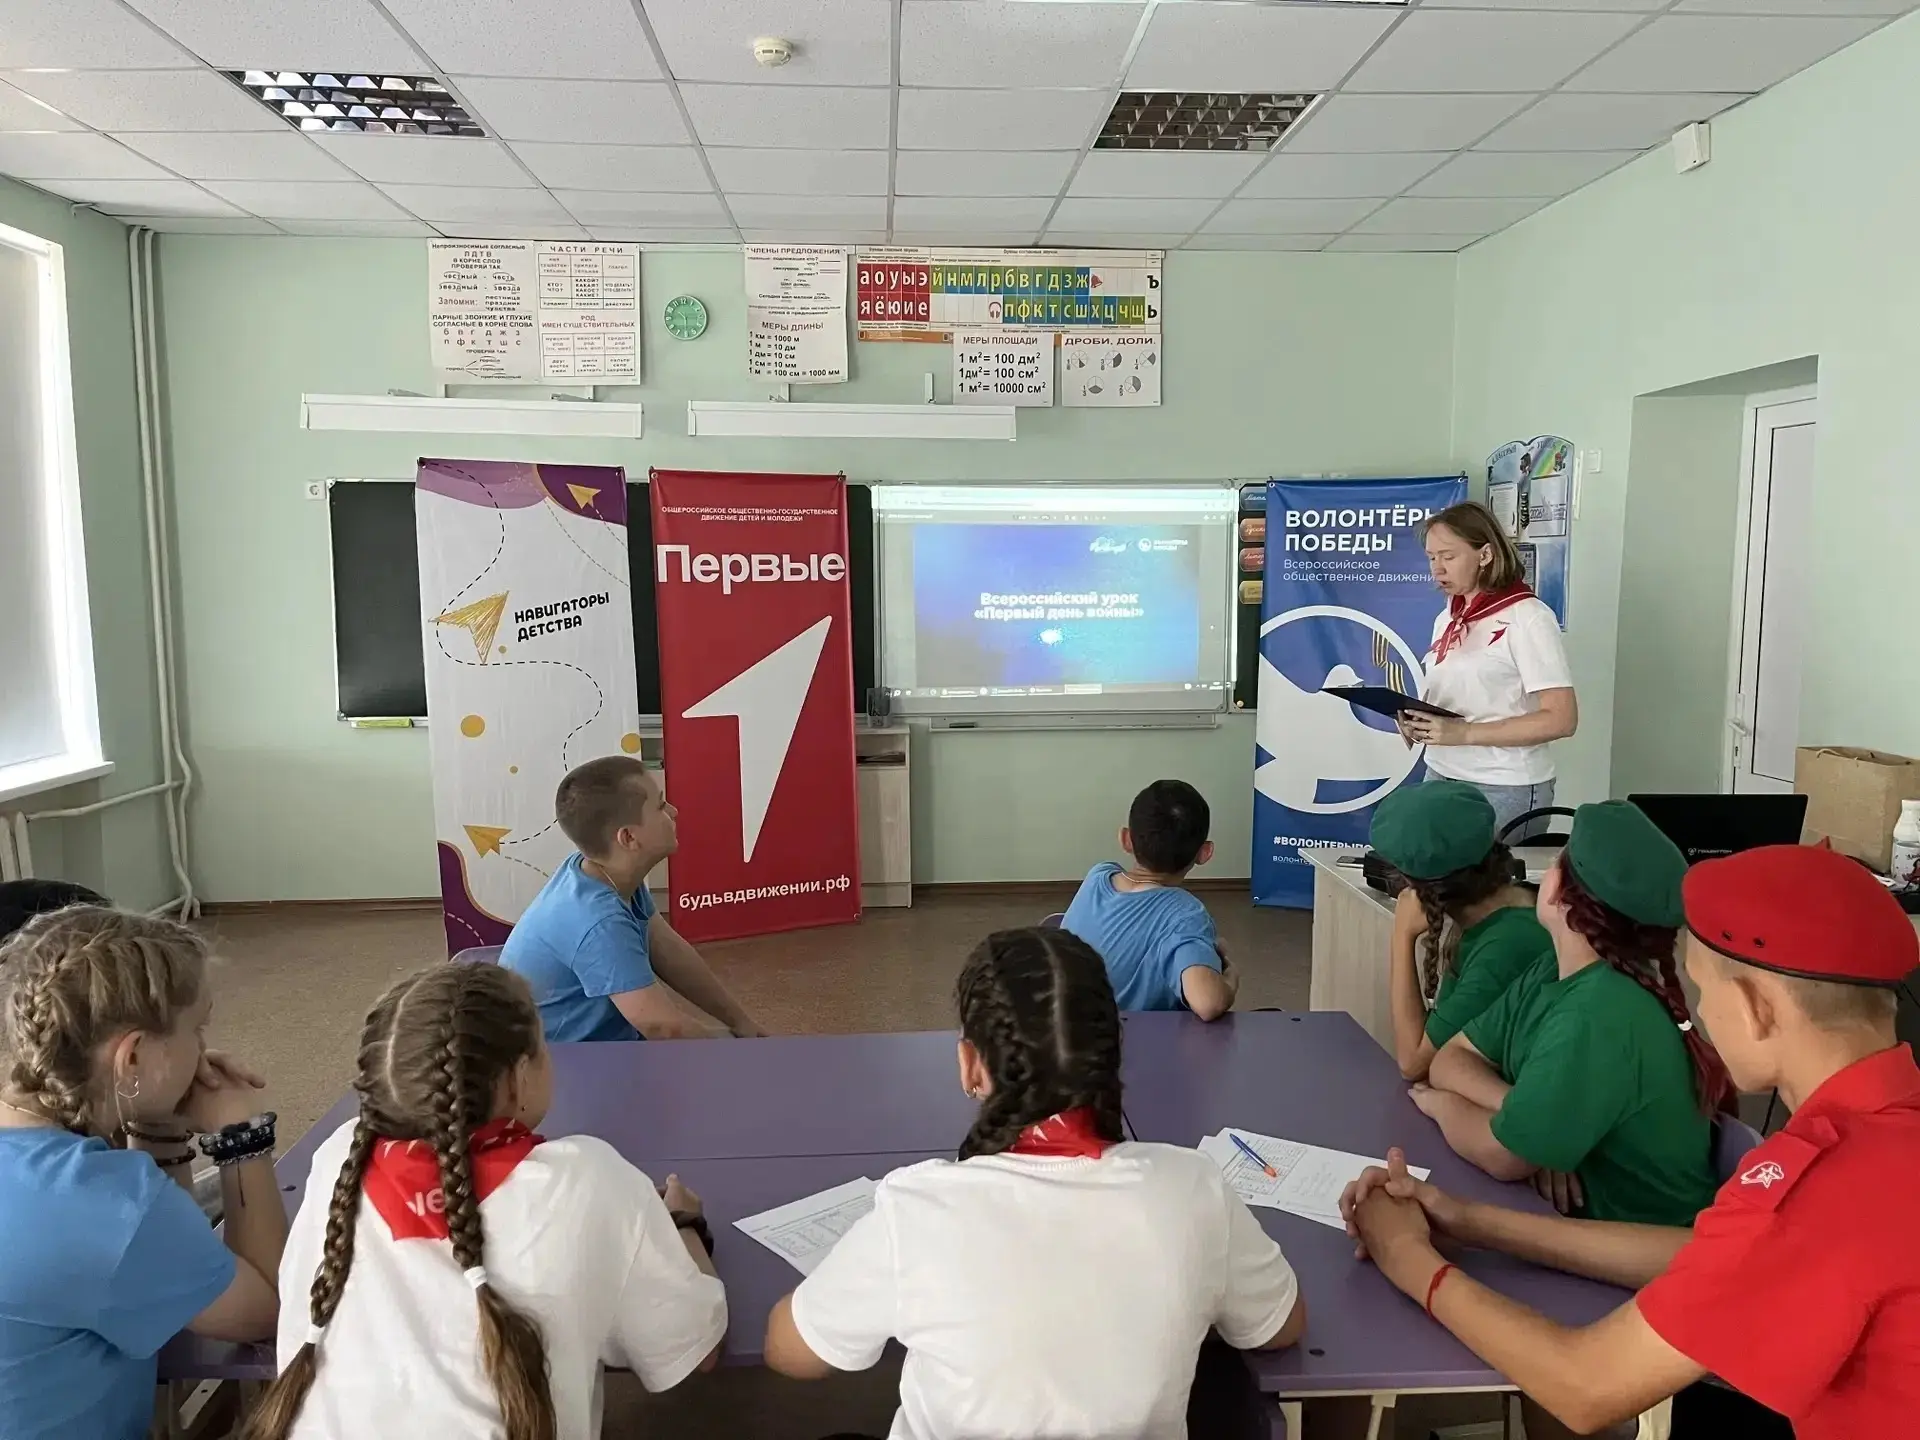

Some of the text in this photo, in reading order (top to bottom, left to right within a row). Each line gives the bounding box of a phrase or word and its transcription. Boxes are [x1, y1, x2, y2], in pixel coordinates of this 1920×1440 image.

[860, 271, 870, 285] а
[875, 271, 884, 285] о
[889, 271, 899, 290] у
[903, 272, 914, 285] ы
[918, 272, 928, 286] э
[933, 268, 942, 286] й
[948, 272, 957, 286] н
[960, 272, 973, 286] м
[976, 272, 986, 287] л
[990, 272, 1000, 292] р
[1005, 268, 1015, 288] б
[1020, 274, 1029, 288] в
[1035, 274, 1043, 288] г
[1048, 274, 1059, 292] д
[1064, 274, 1072, 288] з
[1076, 274, 1089, 288] ж
[860, 301, 871, 315] я
[875, 296, 884, 315] ё
[888, 301, 900, 315] ю
[904, 301, 914, 315] и
[918, 301, 928, 316] е
[1005, 304, 1014, 317] п
[1018, 299, 1030, 322] ф
[1034, 304, 1043, 317] к
[1049, 304, 1058, 318] т
[1064, 304, 1071, 318] с
[1075, 304, 1088, 318] ш
[1091, 304, 1100, 318] х
[1104, 304, 1114, 321] ц
[1119, 304, 1128, 318] ч
[1132, 304, 1144, 321] щ
[762, 321, 824, 332] МЕРЫ ДЛИНЫ
[959, 353, 964, 363] 1
[994, 354, 1015, 364] 100
[994, 368, 1015, 378] 100
[959, 382, 964, 392] 1
[994, 383, 1024, 393] 10000
[1285, 534, 1392, 554] ПОБЕДЫ
[656, 544, 845, 594] Первые
[1284, 559, 1380, 570] Всероссийское
[1283, 571, 1435, 583] общественное движени
[980, 591, 1139, 607] Всероссийский урок
[514, 592, 610, 624] НАВИГАТОРЫ
[974, 606, 1144, 621] «Первый день войны»
[518, 615, 582, 642] ДЕТСТВА
[679, 874, 850, 910] будьвдвижении.рф
